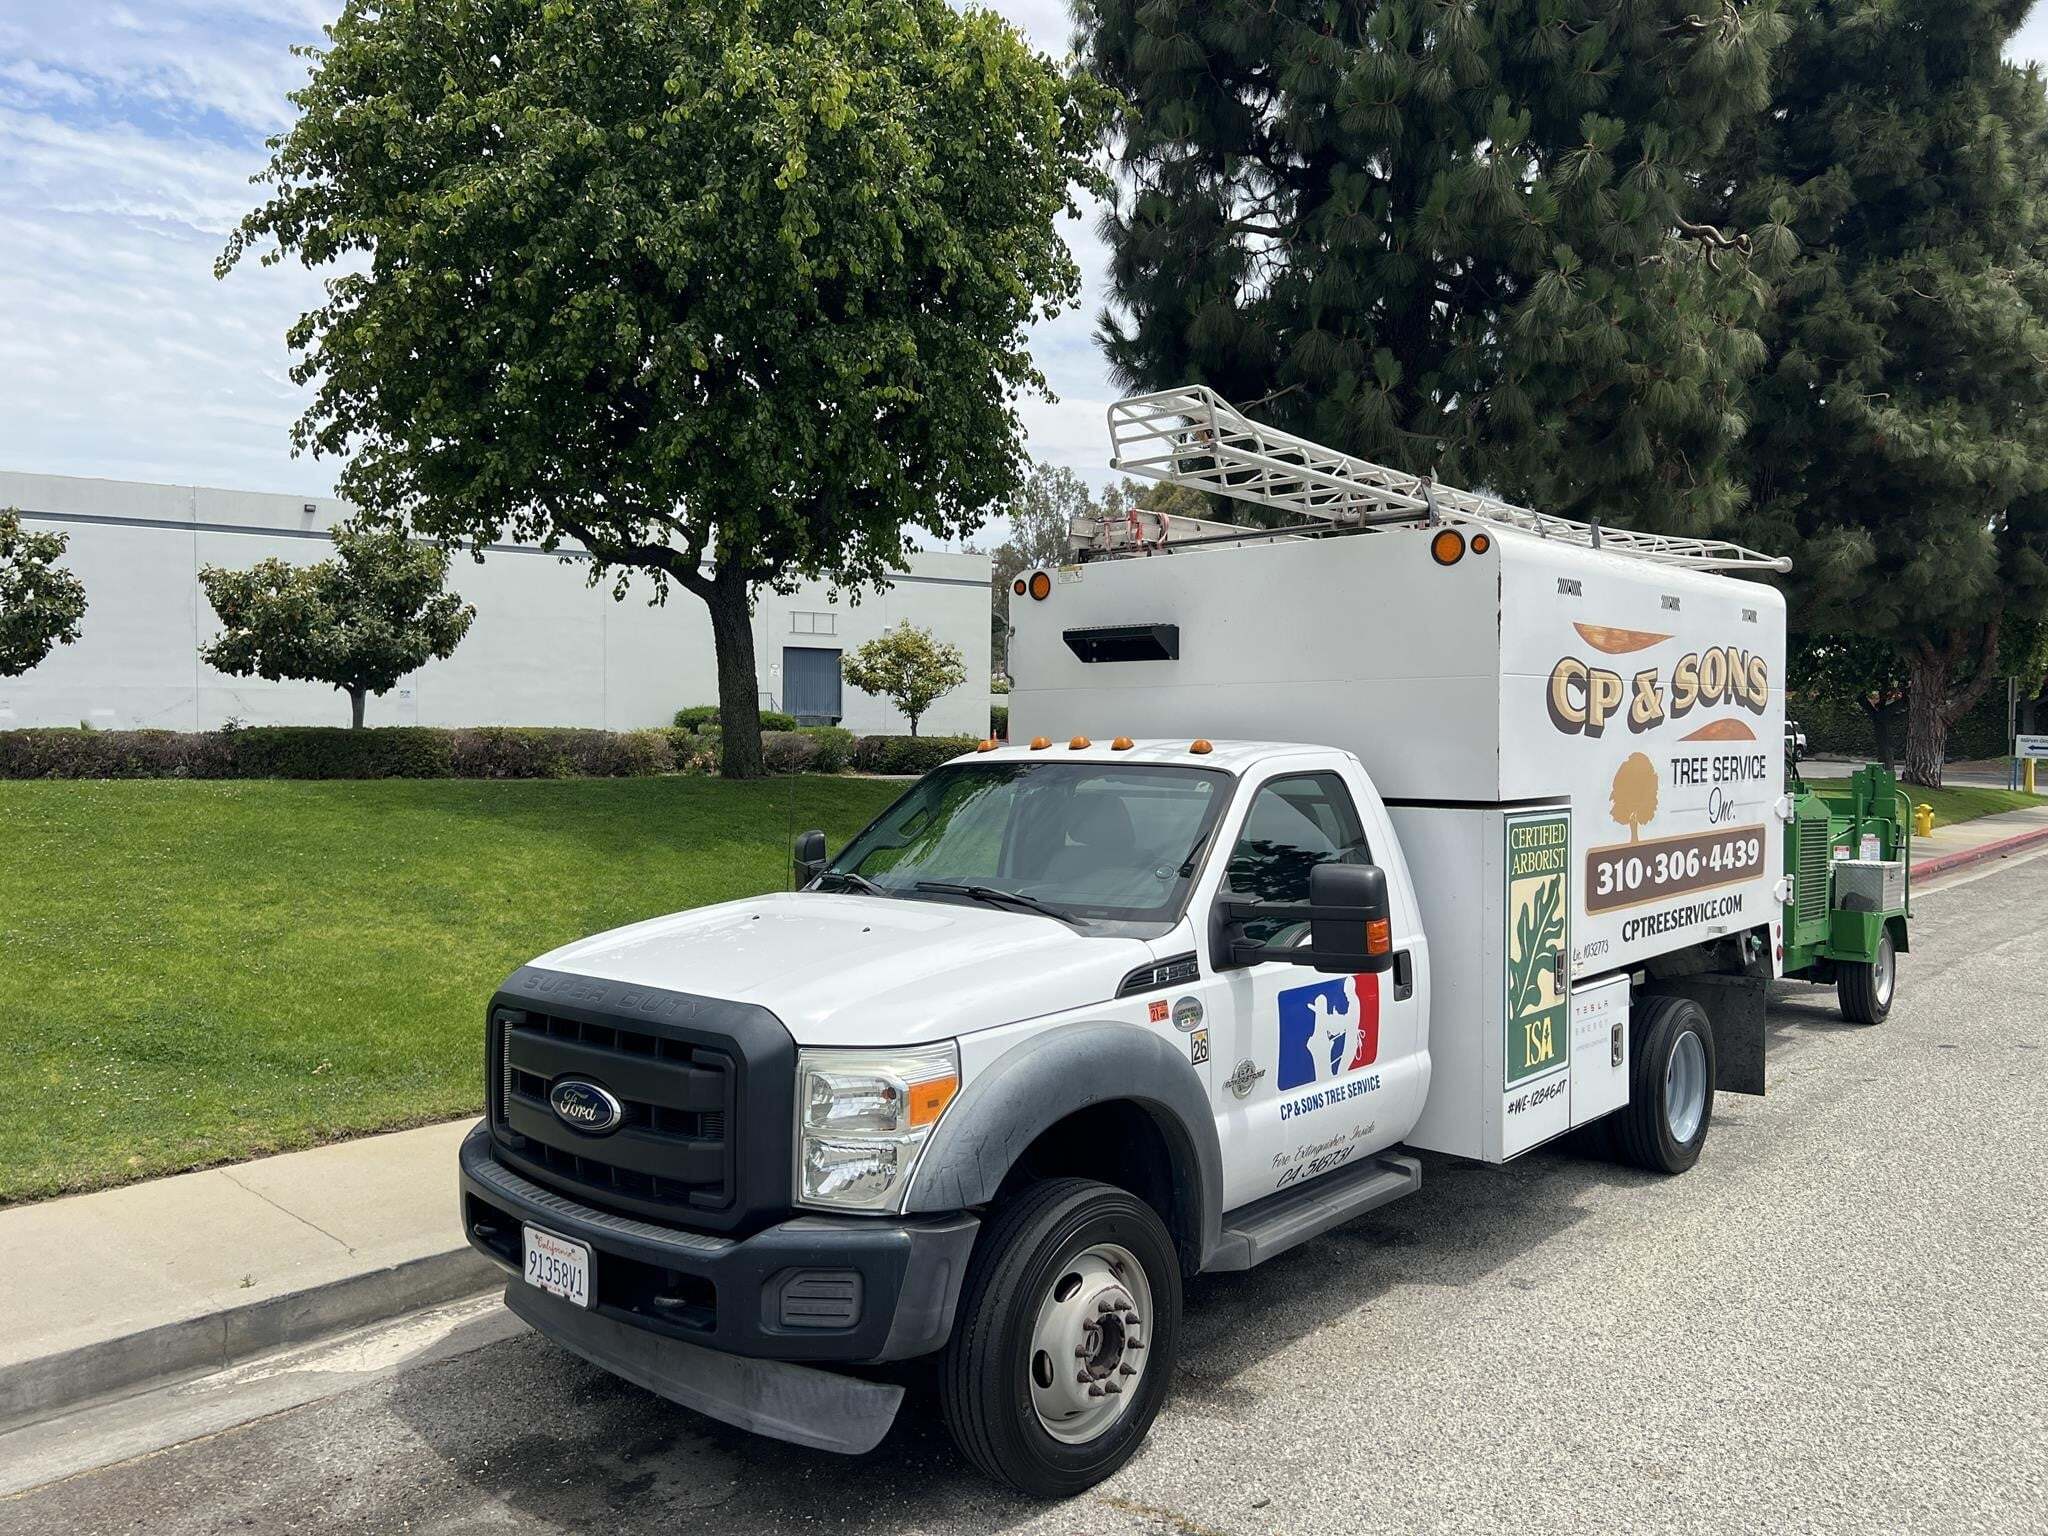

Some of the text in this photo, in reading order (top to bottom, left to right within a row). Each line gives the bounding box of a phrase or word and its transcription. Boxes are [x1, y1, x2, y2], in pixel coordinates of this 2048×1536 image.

[1546, 646, 1768, 739] CP & SONS
[1671, 755, 1766, 785] TREE SERVICE
[1708, 786, 1736, 824] Inc.
[1511, 823, 1567, 850] CERTIFIED
[1511, 847, 1566, 876] ARBORIST
[1622, 894, 1743, 943] CPTREESERVICE.COM
[522, 974, 701, 1020] SUPER DUTY
[1193, 1038, 1207, 1061] 26
[1524, 1016, 1555, 1068] ISA
[560, 1089, 597, 1122] Ford
[1325, 1085, 1346, 1107] TREE
[1347, 1074, 1381, 1100] SERVICE
[1272, 1151, 1291, 1169] Fire
[1276, 1144, 1356, 1188] CA 518731
[537, 1236, 572, 1257] California
[529, 1250, 584, 1297] 91358V1
